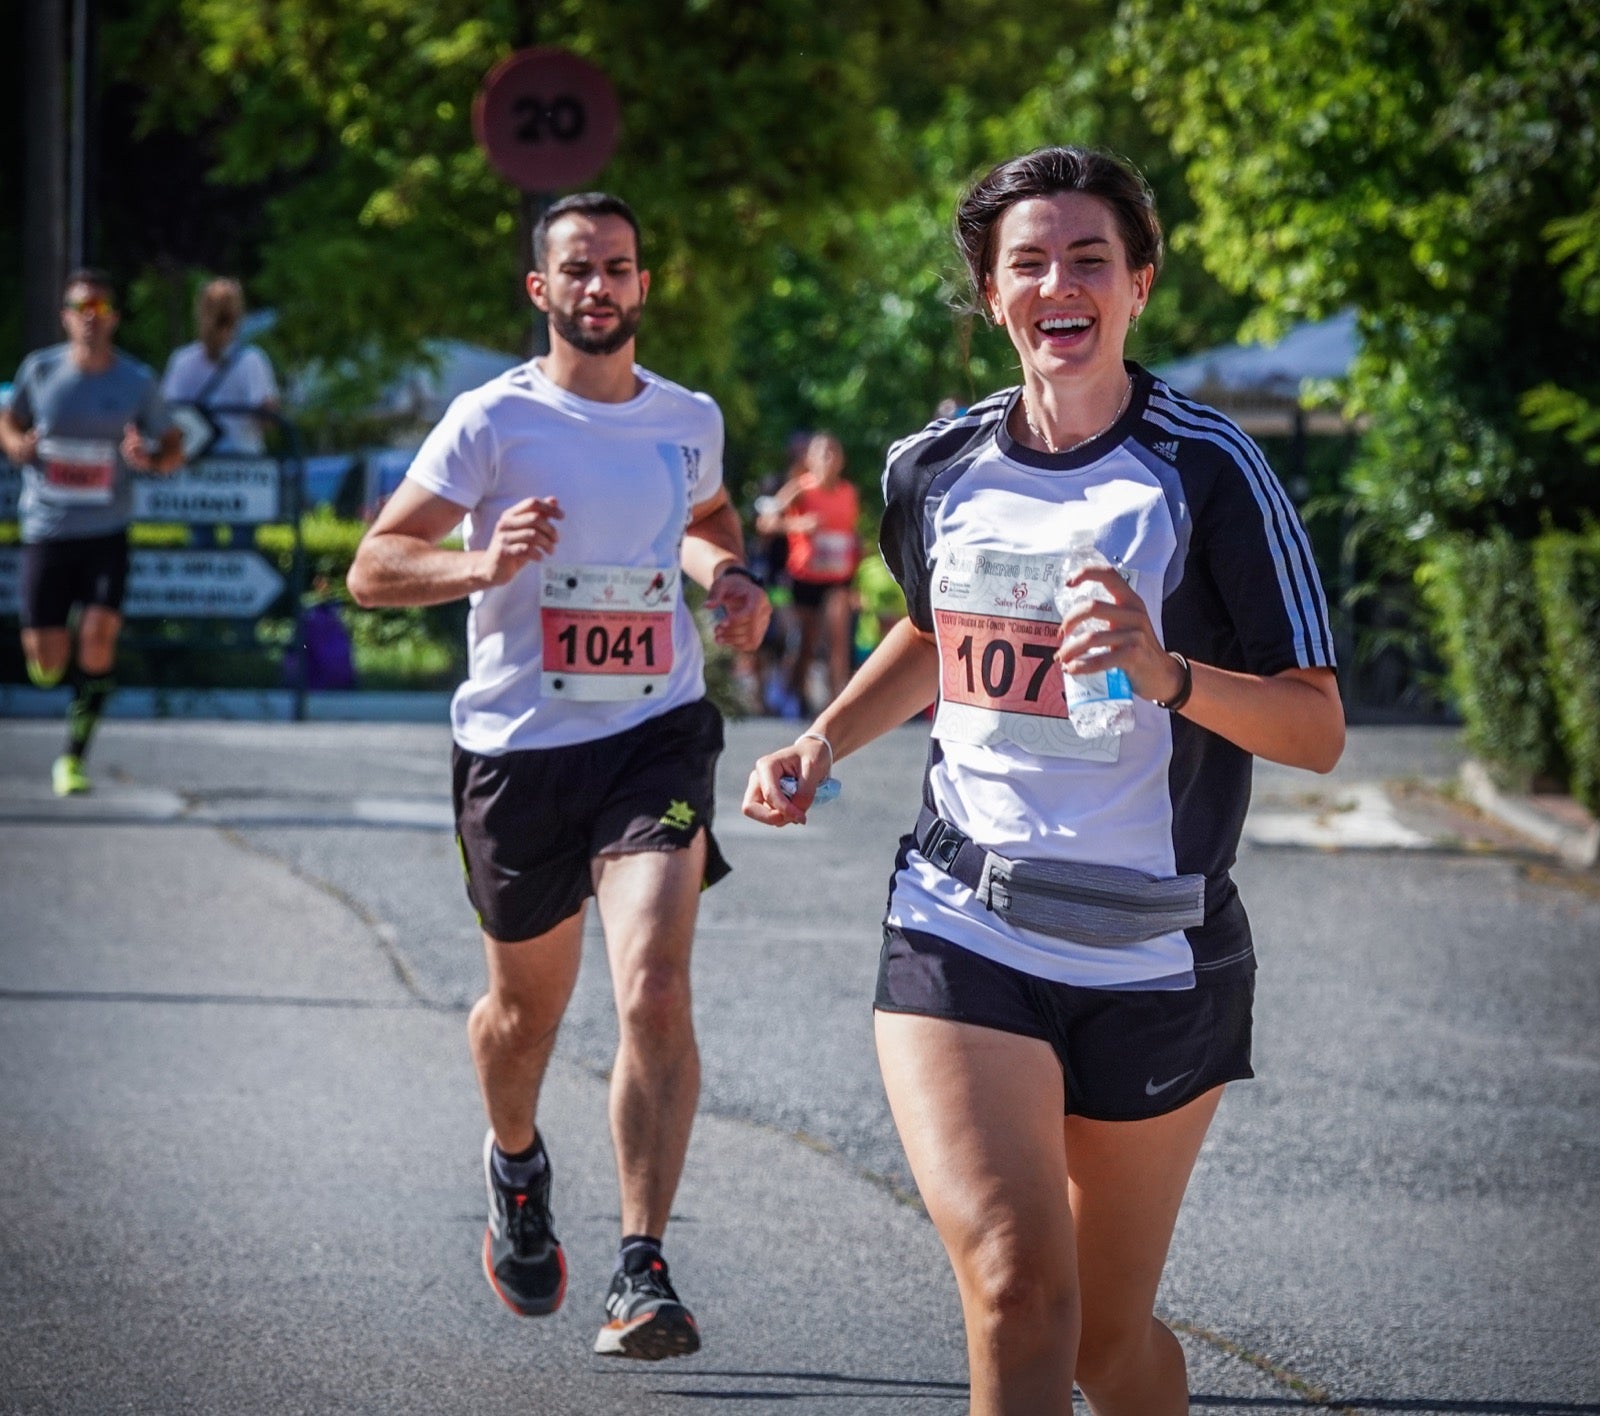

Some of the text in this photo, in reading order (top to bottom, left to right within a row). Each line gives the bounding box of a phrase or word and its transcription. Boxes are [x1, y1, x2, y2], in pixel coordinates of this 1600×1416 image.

[511, 95, 585, 143] 20
[558, 624, 655, 666] 1041
[957, 634, 1066, 703] 107
